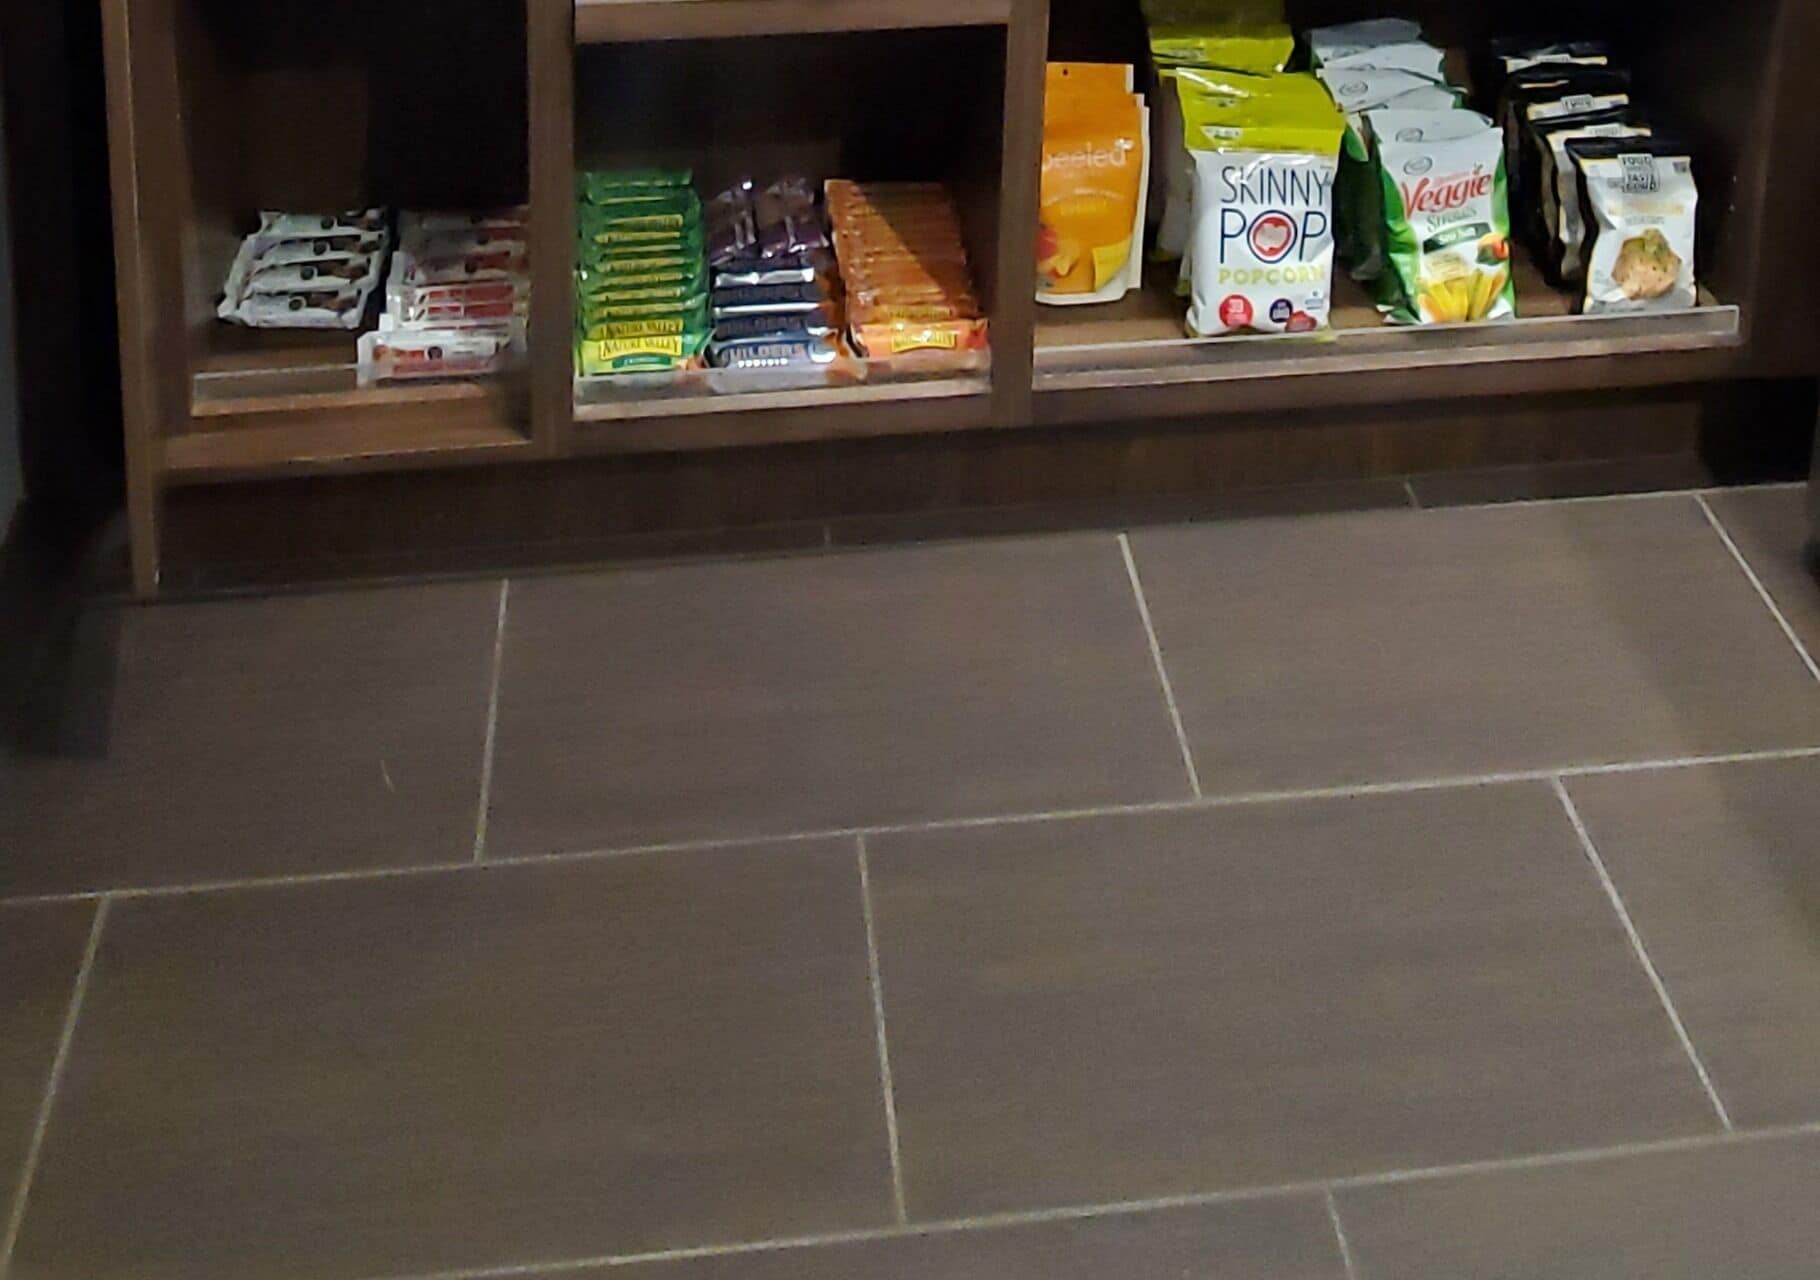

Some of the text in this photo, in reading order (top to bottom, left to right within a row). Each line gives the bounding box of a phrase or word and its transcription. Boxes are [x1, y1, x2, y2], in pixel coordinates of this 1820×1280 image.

[1220, 161, 1328, 205] SKINNY
[1401, 174, 1491, 219] Veggie
[1219, 207, 1327, 264] POP
[1218, 265, 1326, 285] POPCORN
[602, 336, 679, 357] NATURE VALLEY
